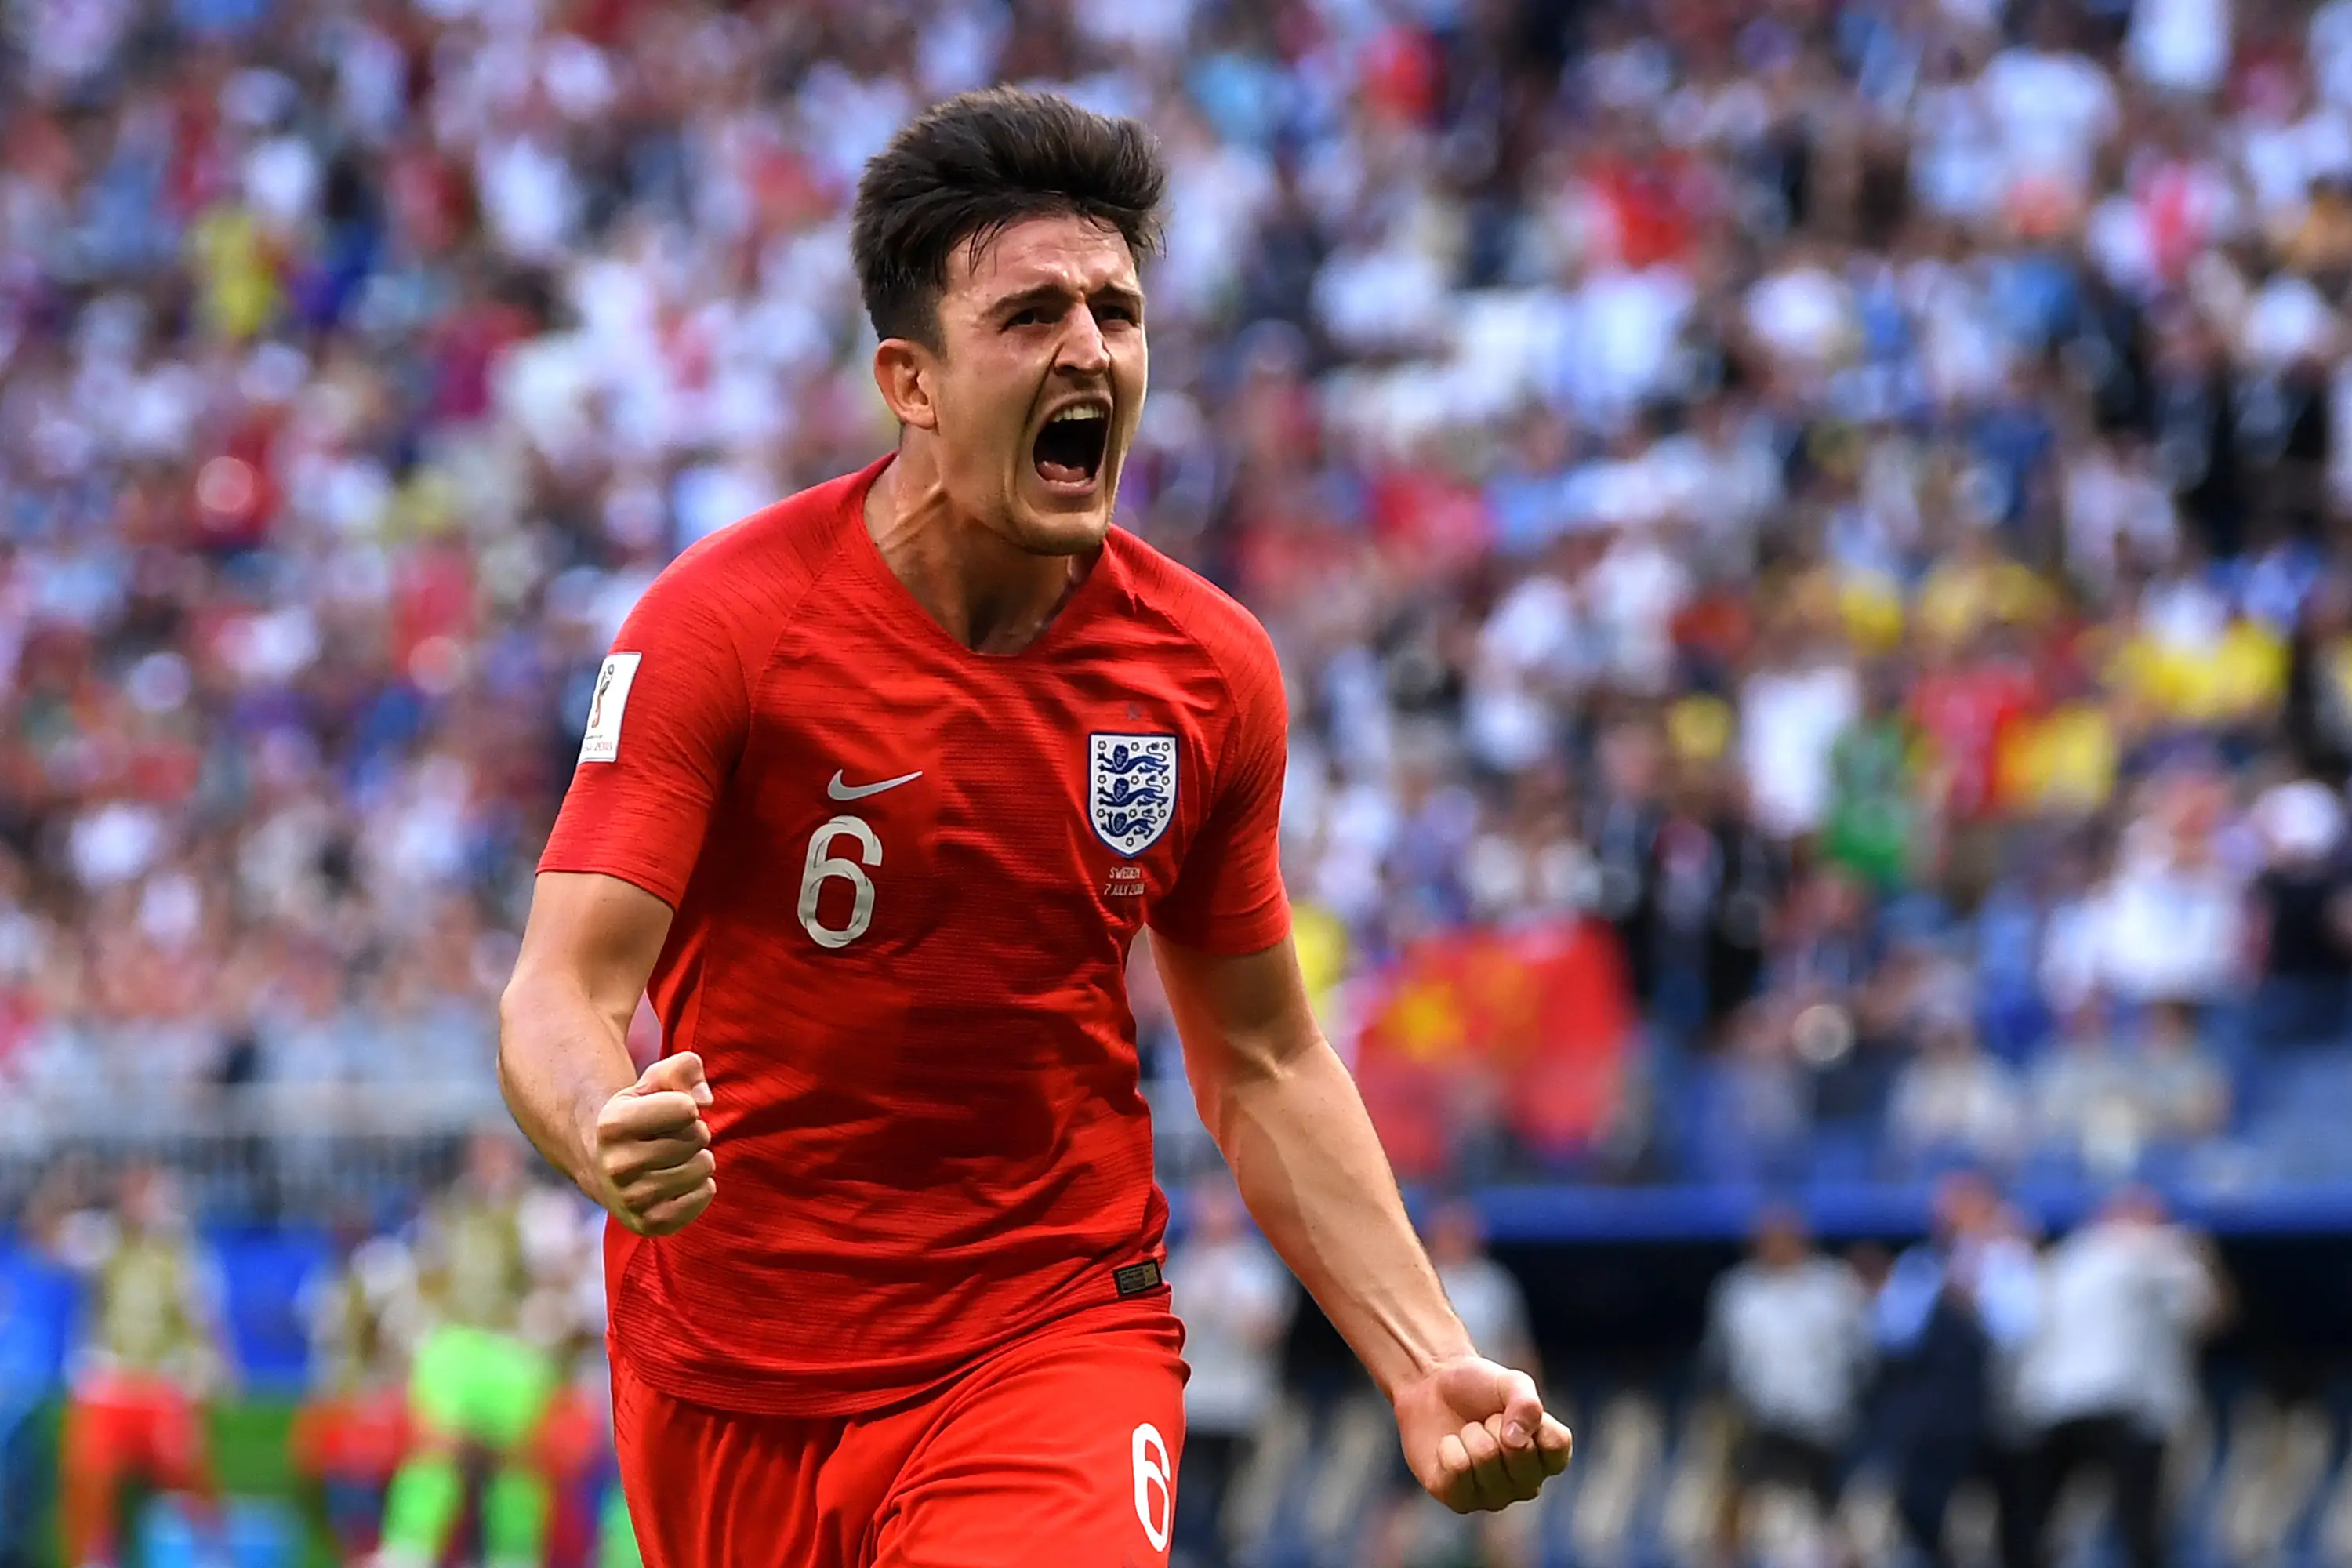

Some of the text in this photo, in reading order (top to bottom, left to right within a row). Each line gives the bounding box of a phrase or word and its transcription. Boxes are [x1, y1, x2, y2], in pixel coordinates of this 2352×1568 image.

[797, 815, 883, 949] 6
[1103, 883, 1112, 896] 7
[1110, 884, 1129, 896] JULY
[1109, 866, 1141, 880] SWEDEN
[1131, 1423, 1171, 1552] 6
